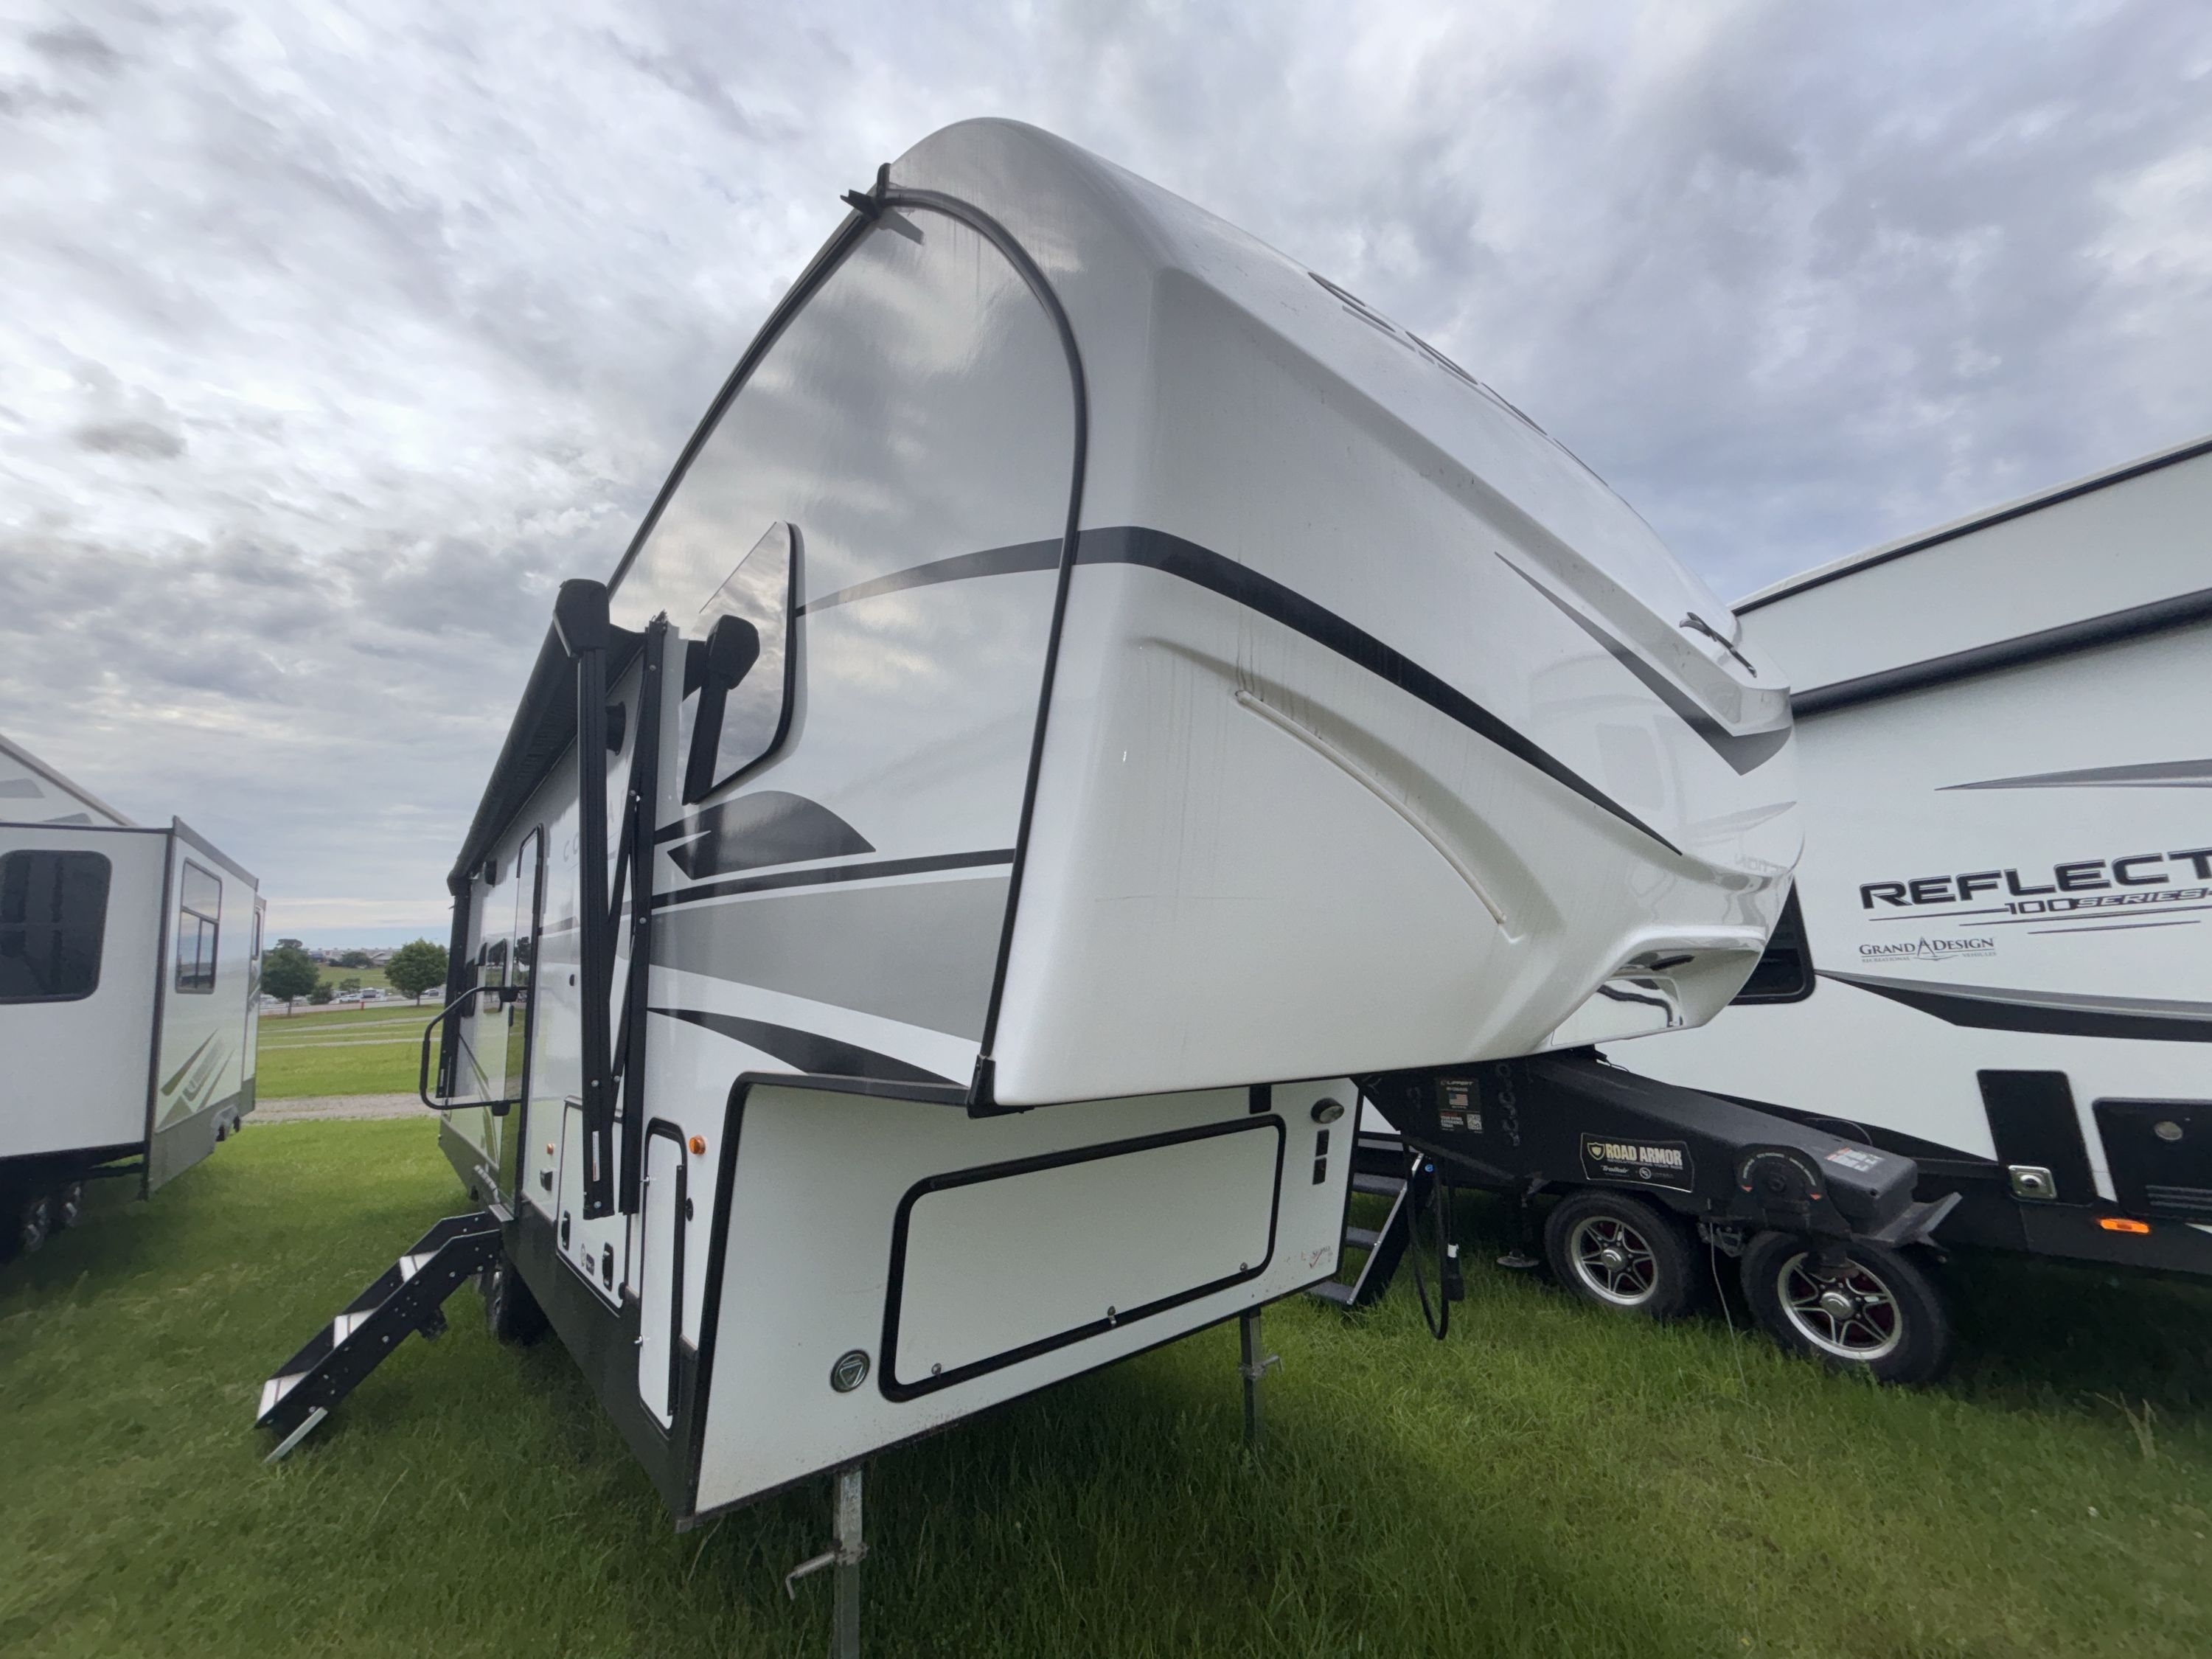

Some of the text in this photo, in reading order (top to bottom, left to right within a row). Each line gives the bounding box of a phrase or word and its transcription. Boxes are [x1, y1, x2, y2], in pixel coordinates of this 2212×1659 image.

[1860, 847, 2212, 909] REFLECT
[2005, 888, 2203, 914] 100 SERIES
[1859, 943, 1916, 955] GRAND
[1605, 1143, 1683, 1166] ROAD ARMOR
